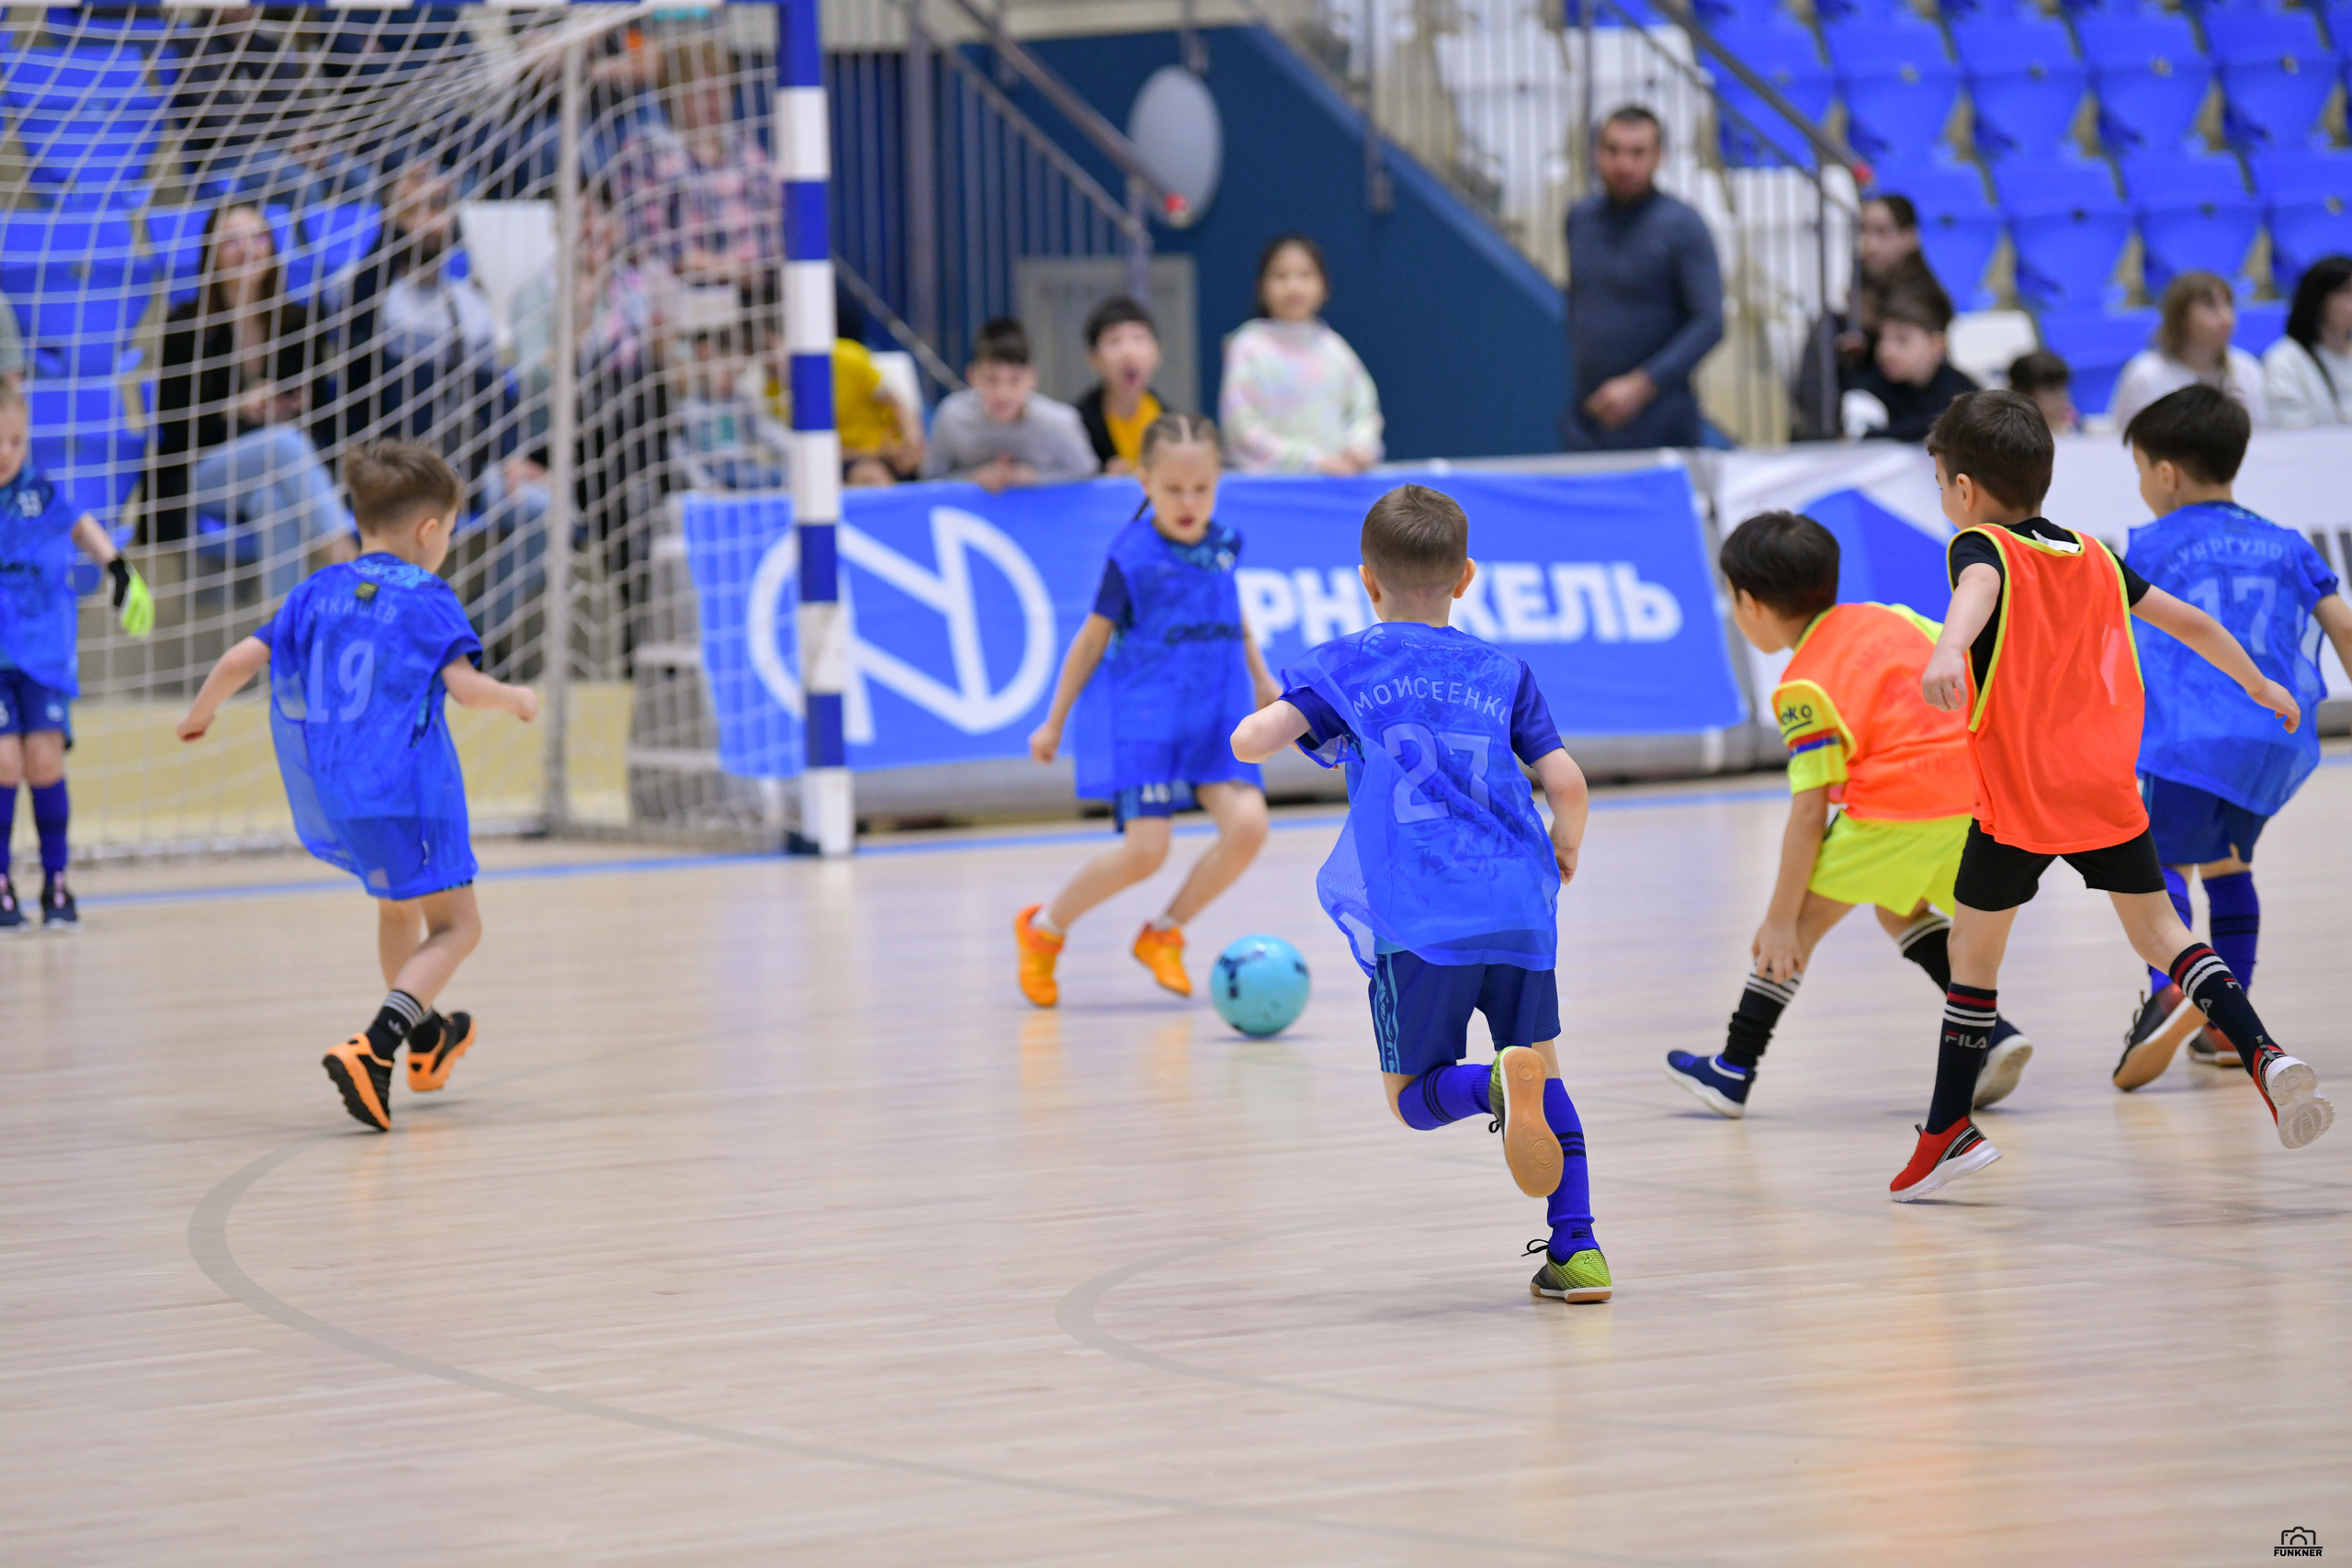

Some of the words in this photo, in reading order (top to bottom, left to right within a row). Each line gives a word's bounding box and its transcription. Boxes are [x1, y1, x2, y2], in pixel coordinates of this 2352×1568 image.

[2187, 576, 2277, 656] 17
[305, 638, 375, 723] 19
[1781, 705, 1813, 726] eko
[1383, 722, 1491, 824] 27
[1944, 1030, 1988, 1050] FILA
